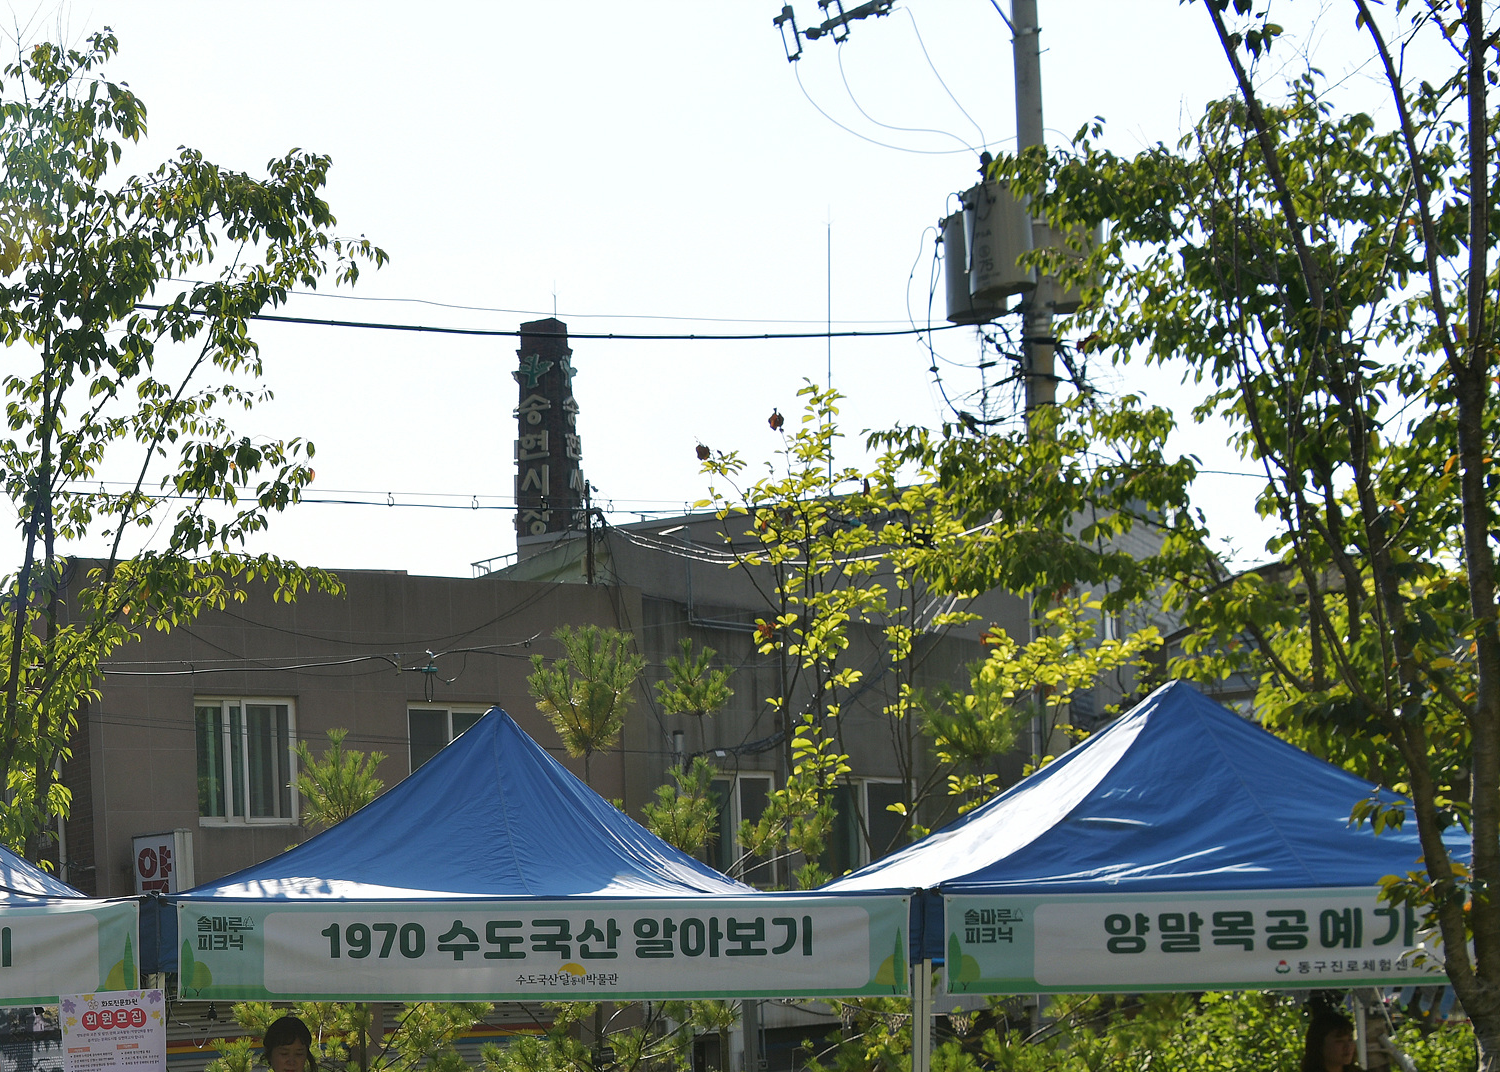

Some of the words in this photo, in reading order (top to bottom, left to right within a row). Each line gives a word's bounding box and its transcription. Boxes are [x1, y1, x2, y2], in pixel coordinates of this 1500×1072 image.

[516, 393, 552, 536] 송현시장
[138, 845, 172, 894] 약
[197, 915, 254, 933] 솔마루
[964, 908, 1023, 926] 솔마루
[198, 934, 244, 951] 피크닉
[321, 922, 426, 959] 1970
[437, 918, 622, 961] 수도국산
[633, 915, 813, 958] 알아보기
[965, 926, 1013, 944] 피크닉
[515, 972, 619, 986] 수도국산달동네박물관
[101, 998, 138, 1007] 화도진문화원
[86, 1010, 142, 1026] 회원모집
